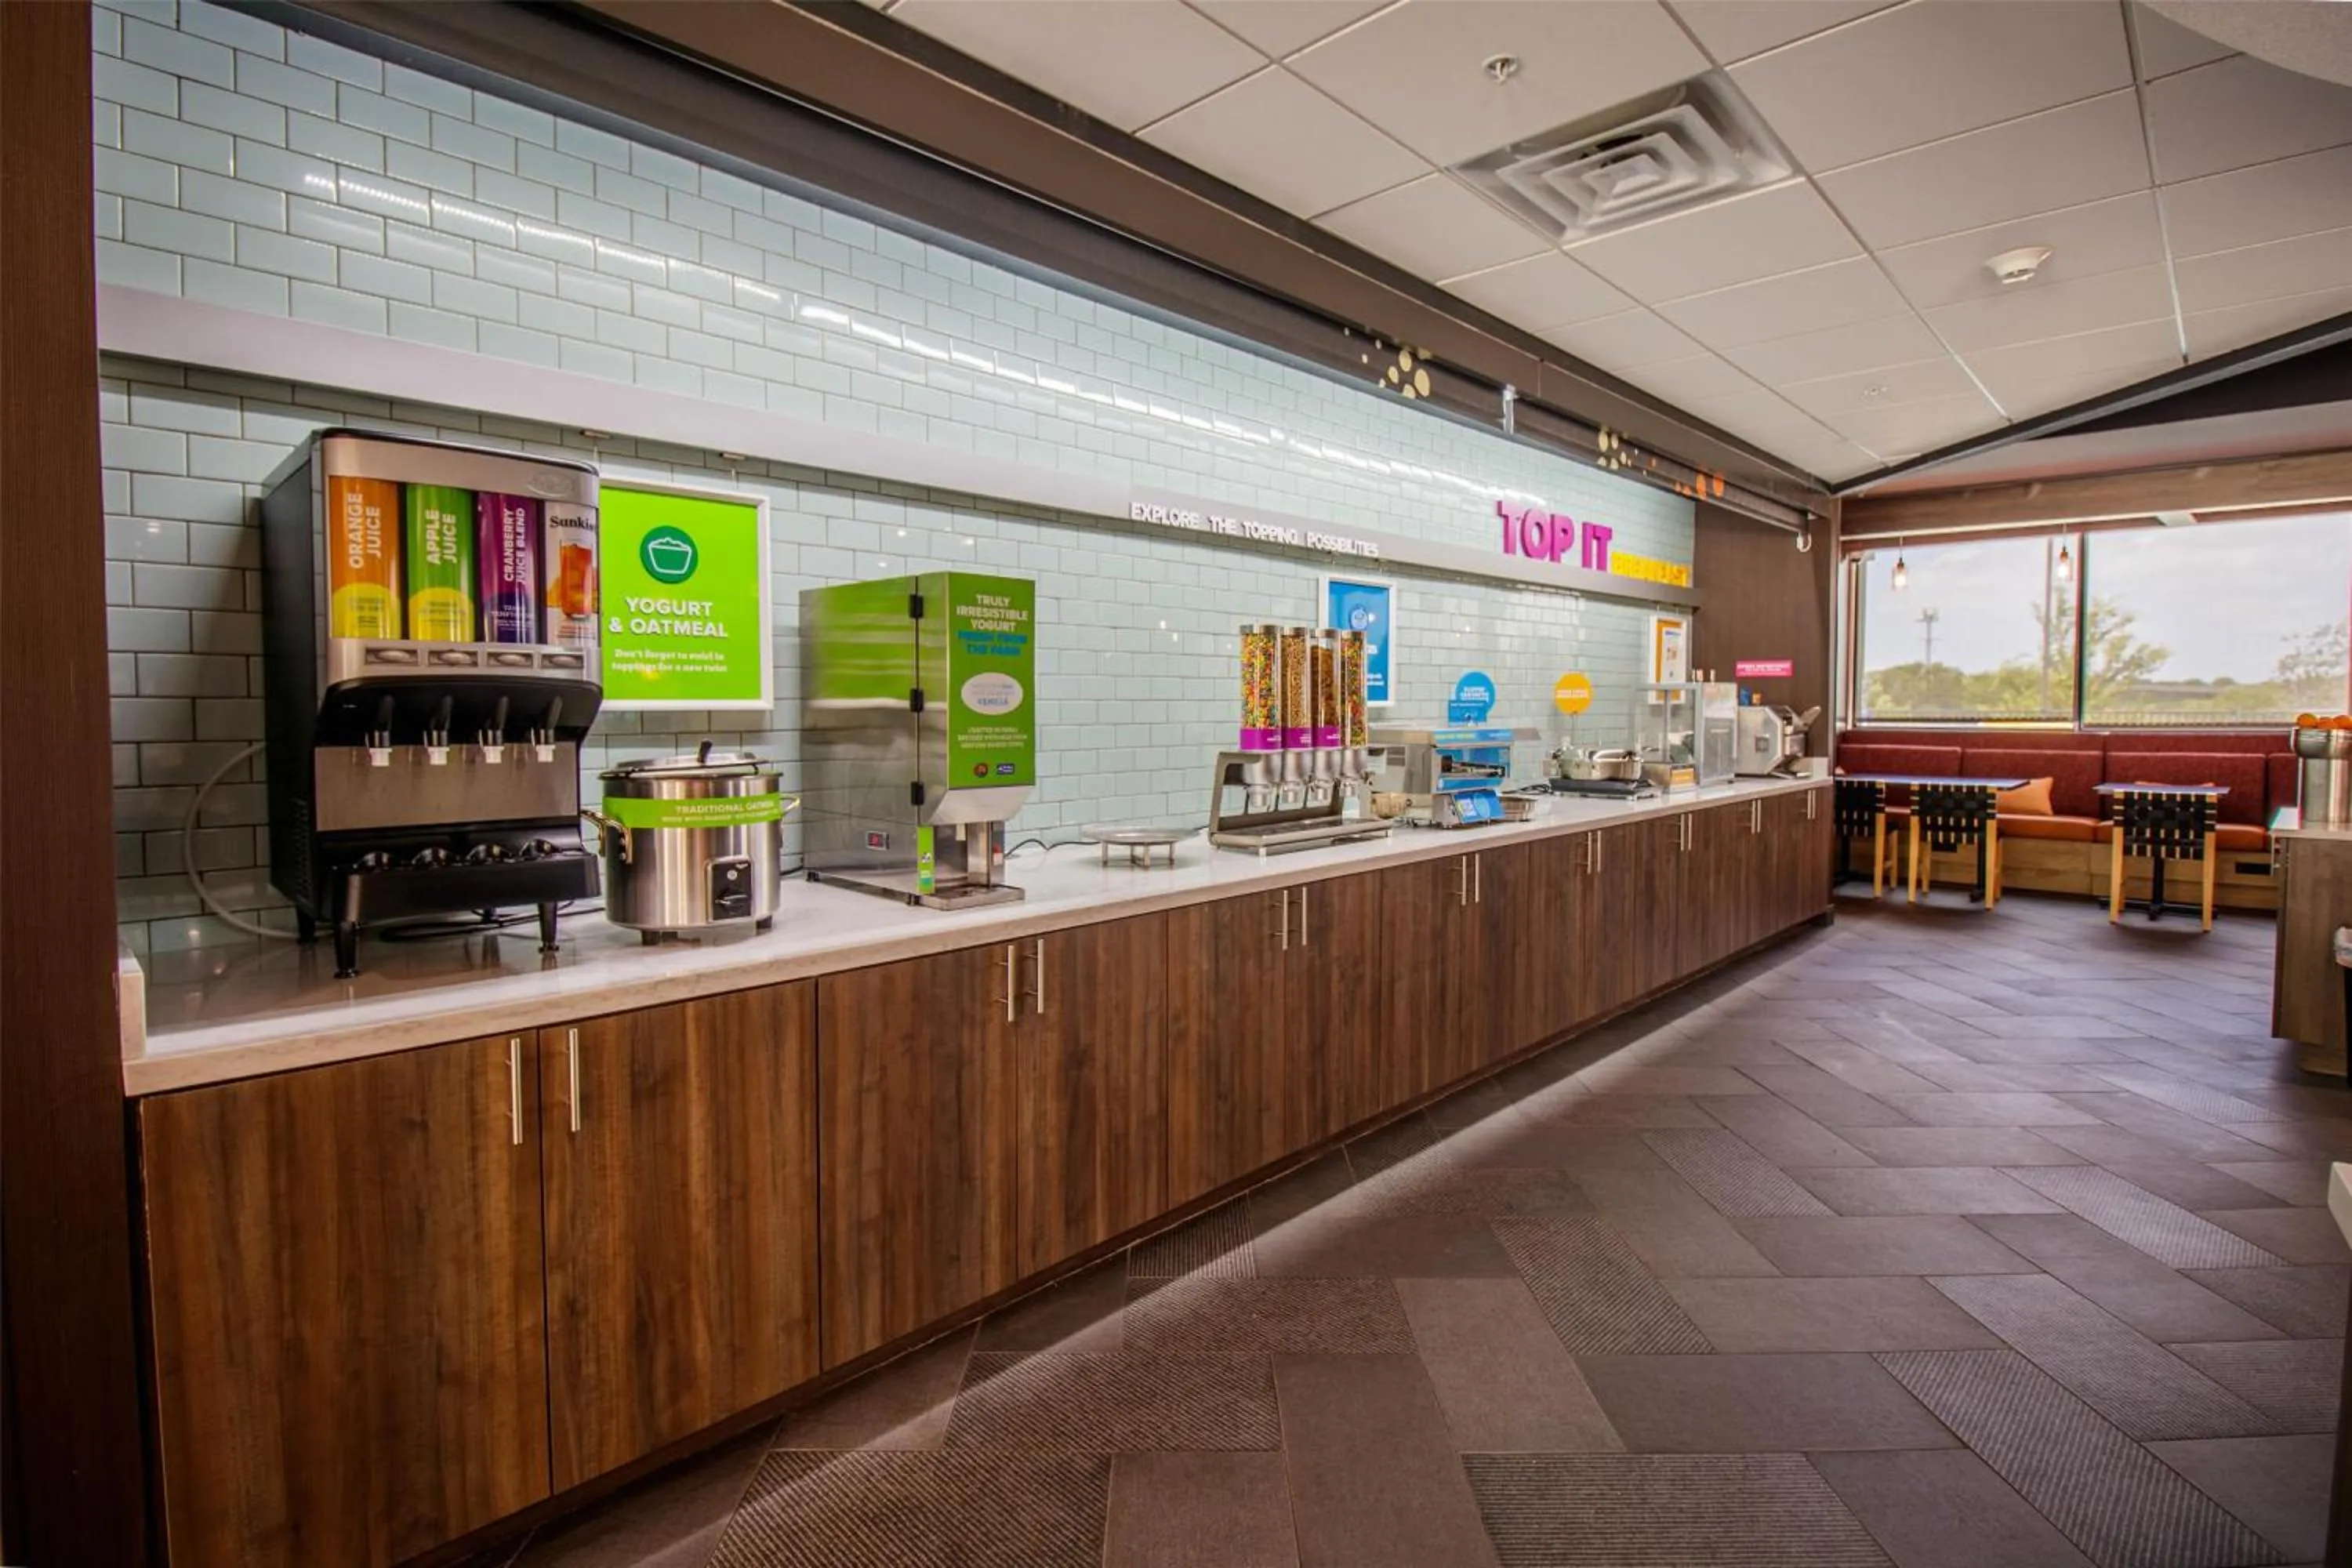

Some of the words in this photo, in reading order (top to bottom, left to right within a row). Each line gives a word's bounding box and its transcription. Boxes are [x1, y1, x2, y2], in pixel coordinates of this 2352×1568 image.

[348, 493, 365, 569] ORANGE
[366, 506, 381, 559] JUICE
[516, 507, 525, 548] BLEND
[550, 515, 596, 531] Sunkis
[1129, 502, 1200, 528] EXPLORE
[1208, 515, 1237, 534] THE
[426, 509, 441, 564] APPLE
[443, 514, 457, 564] JUICE
[503, 508, 514, 582] CRANBERRY
[1497, 500, 1575, 563] TOP
[1581, 521, 1613, 572] IT
[626, 596, 713, 617] YOGURT
[956, 605, 1028, 620] IRRESISTIBLE
[976, 593, 1012, 607] TRULY
[608, 617, 623, 633] &
[630, 618, 728, 638] OATMEAL
[971, 619, 1016, 632] YOGURT
[675, 803, 744, 815] TRADITIONAL
